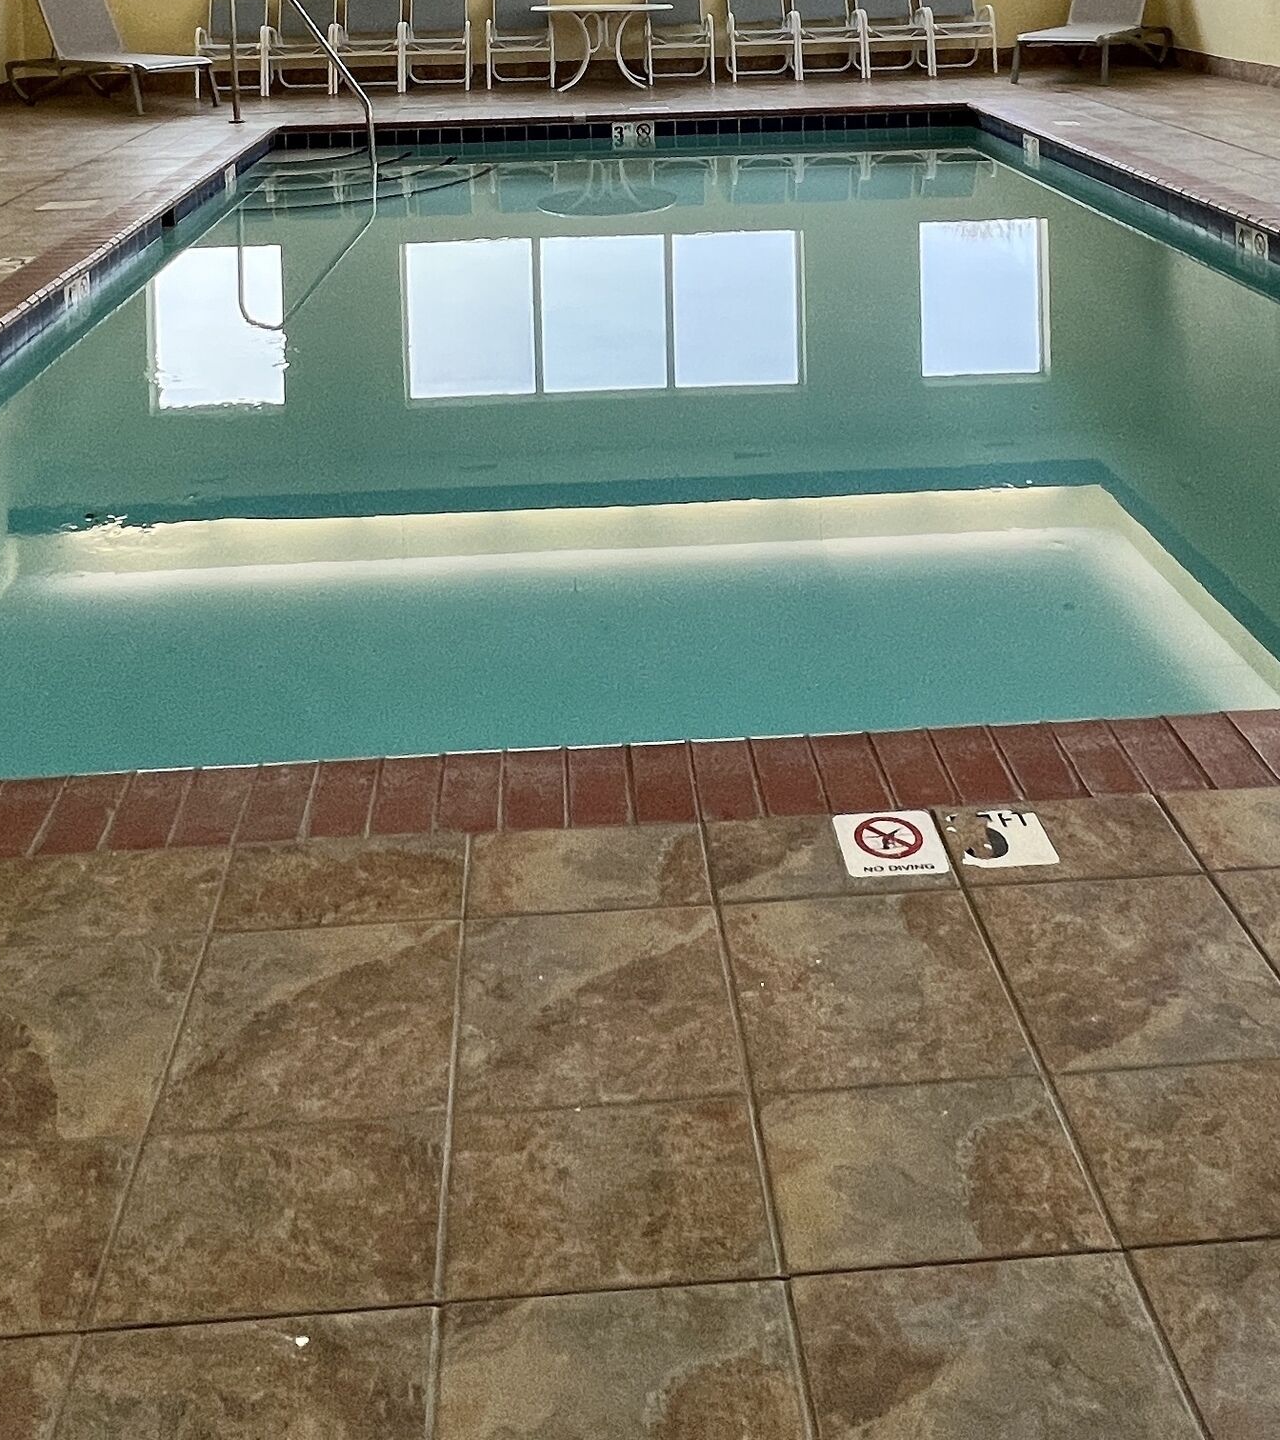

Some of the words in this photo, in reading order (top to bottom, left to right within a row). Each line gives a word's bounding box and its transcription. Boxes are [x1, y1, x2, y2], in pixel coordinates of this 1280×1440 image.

[998, 812, 1027, 828] FT
[863, 865, 885, 873] NO
[888, 863, 936, 872] DIVING
